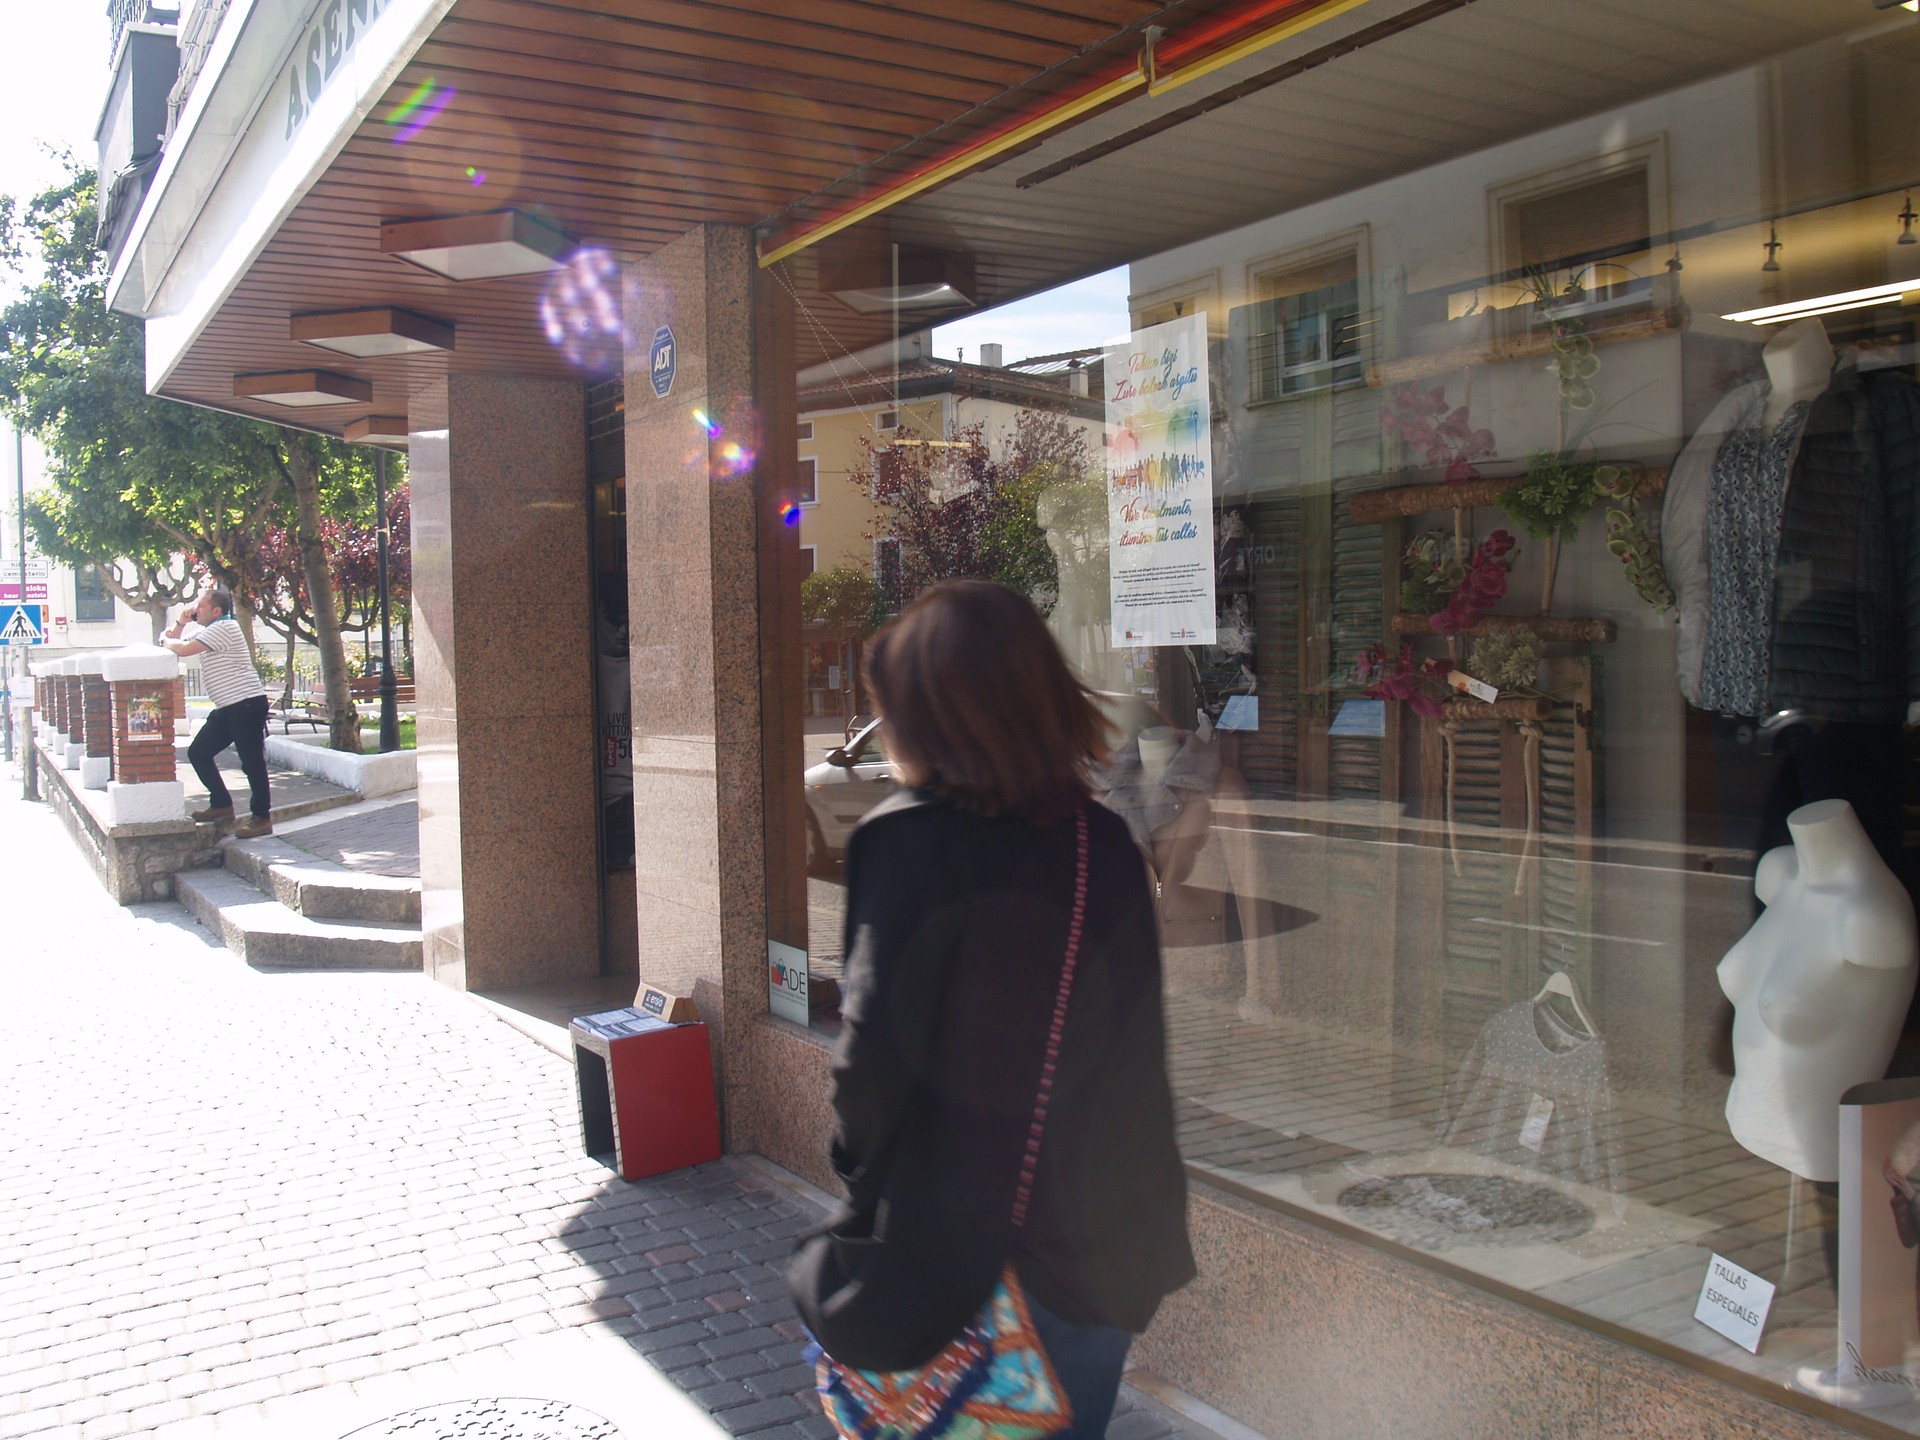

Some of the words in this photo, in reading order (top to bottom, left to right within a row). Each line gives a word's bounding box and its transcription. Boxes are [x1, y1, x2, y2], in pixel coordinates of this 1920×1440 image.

[285, 0, 391, 141] ASEN
[654, 345, 671, 372] ADT
[1120, 497, 1140, 523] Vive
[1155, 527, 1169, 543] tus
[1171, 521, 1198, 541] calles
[607, 712, 627, 725] LIVE
[781, 966, 806, 995] ADE
[1715, 1262, 1748, 1291] TALLAS
[1705, 1287, 1760, 1327] ESPECIALES
